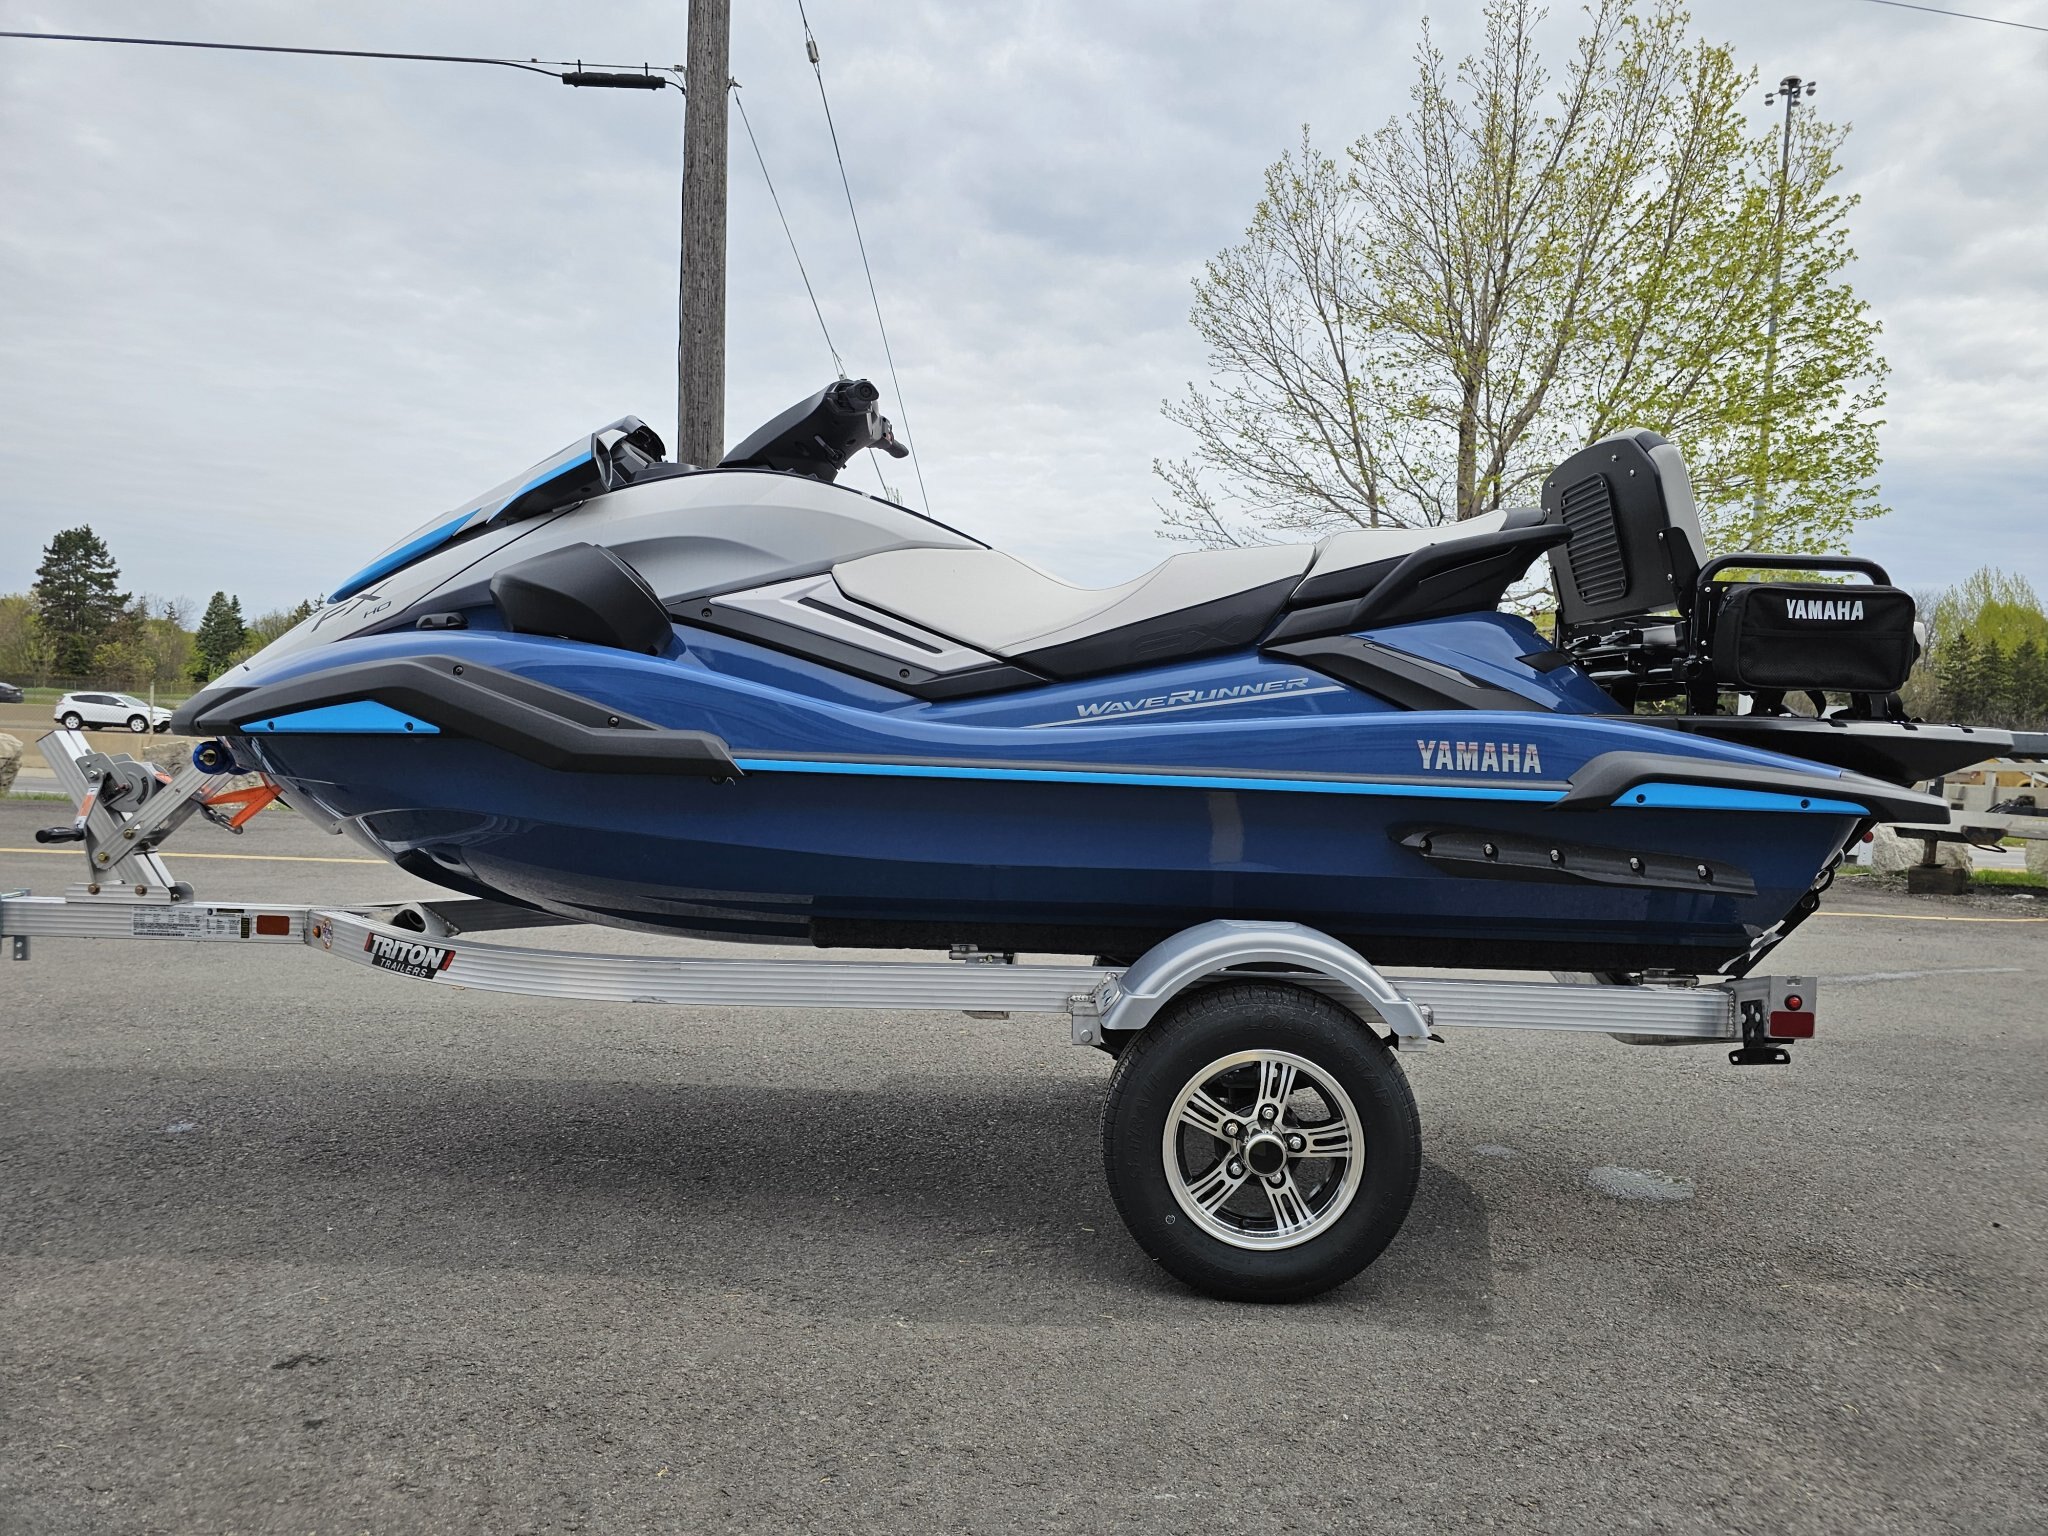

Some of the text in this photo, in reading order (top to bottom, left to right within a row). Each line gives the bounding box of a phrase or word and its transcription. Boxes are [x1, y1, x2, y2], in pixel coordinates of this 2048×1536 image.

[311, 579, 394, 633] FX HO
[1786, 599, 1864, 621] YAMAHA
[1417, 740, 1542, 774] YAMAHA
[372, 934, 446, 969] TRITON
[380, 958, 428, 978] TRAILERS
